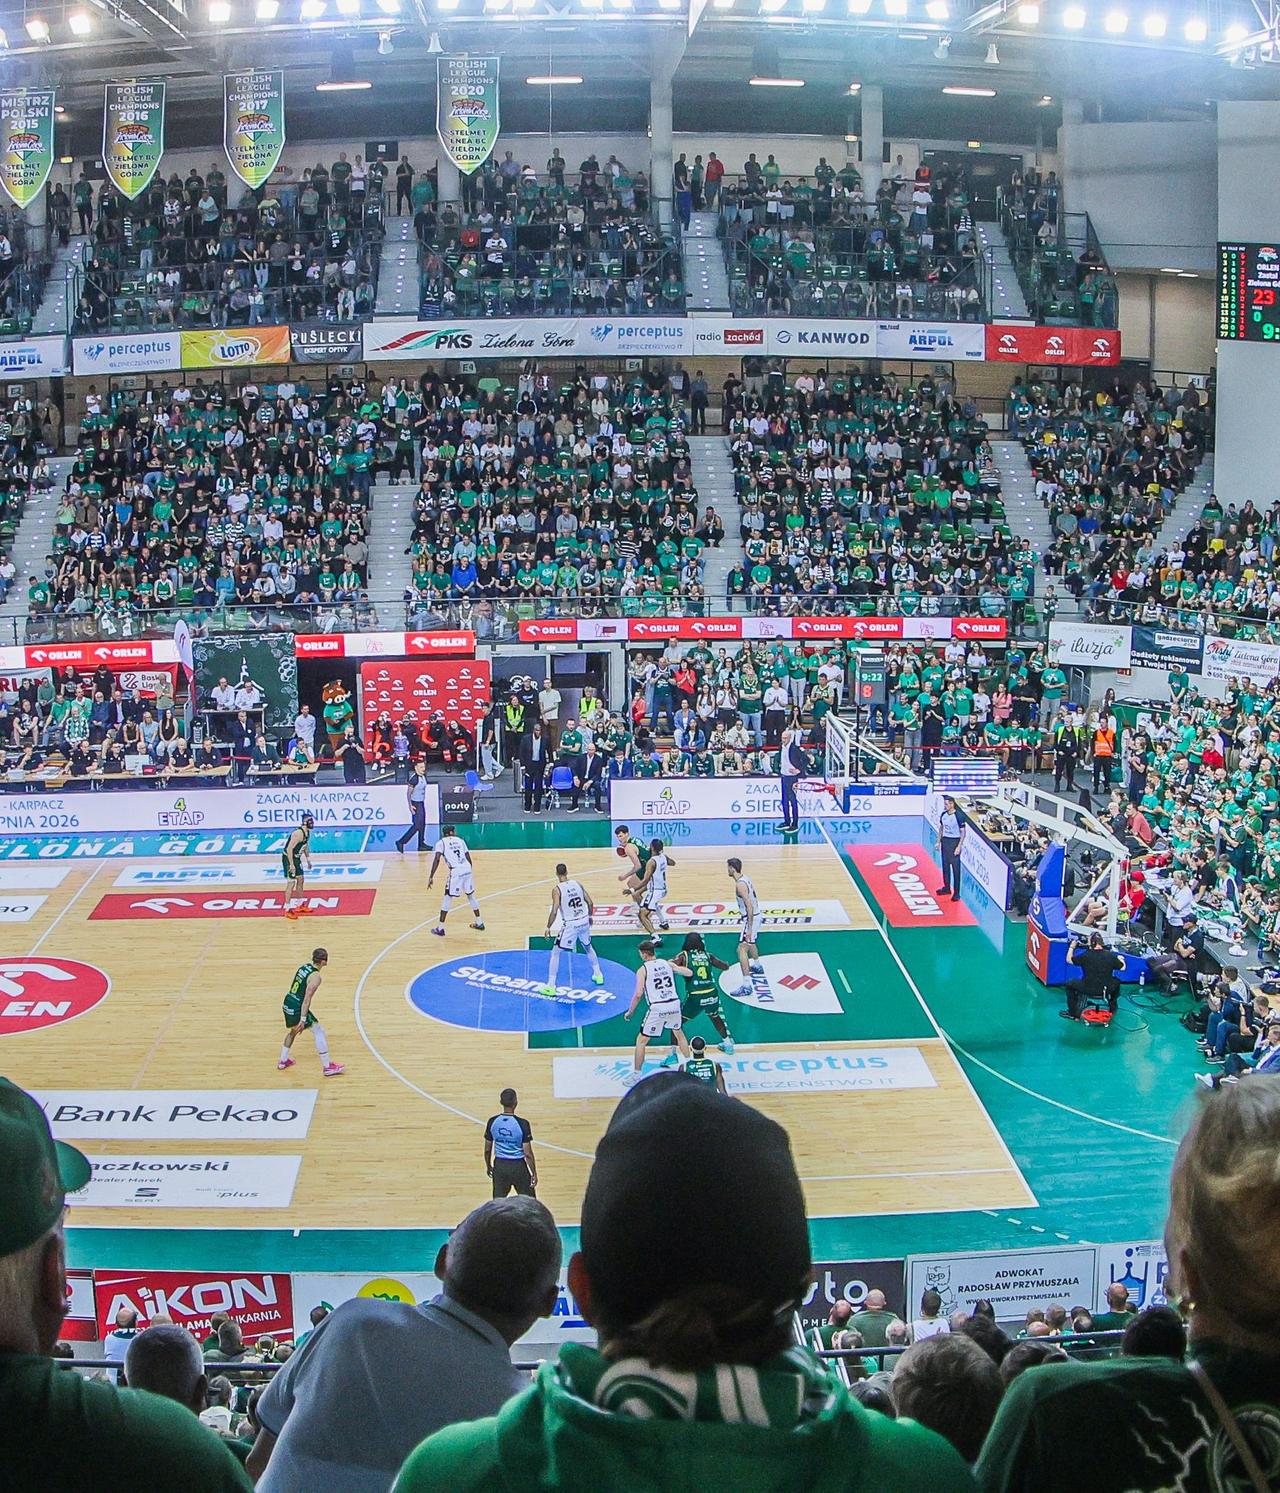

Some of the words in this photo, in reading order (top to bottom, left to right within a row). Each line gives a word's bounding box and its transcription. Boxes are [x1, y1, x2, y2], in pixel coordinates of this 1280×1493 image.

[449, 61, 487, 69] POLISH
[235, 75, 272, 84] POLISH
[117, 86, 154, 94] POLISH
[237, 84, 270, 92] LEAGUE
[451, 85, 485, 96] 2020
[1, 96, 50, 108] MISTRZ
[229, 91, 279, 101] CHAMPIONS
[109, 103, 159, 111] CHAMPIONS
[239, 101, 269, 111] 2017
[1, 107, 49, 118] POLSKI
[119, 111, 149, 121] 2016
[10, 120, 39, 130] 2015
[237, 152, 272, 161] ZIELONA
[114, 162, 149, 170] ZIELONA
[1253, 289, 1276, 305] 23
[291, 330, 361, 344] PUŚLECKI
[618, 325, 683, 341] perceptus
[696, 332, 721, 342] radio
[727, 330, 762, 342] zachód
[798, 331, 870, 345] KANWOD
[435, 334, 472, 349] PKS
[480, 333, 534, 348] Zielona
[542, 332, 575, 348] Góra
[908, 334, 954, 347] ARPOL
[109, 341, 171, 357] perceptus
[220, 343, 250, 359] LOTTO
[0, 353, 43, 366] ARPOL
[542, 625, 572, 635] ORLEN
[649, 623, 680, 633] ORLEN
[706, 623, 737, 632] ORLEN
[813, 623, 842, 632] ORLEN
[869, 623, 898, 632] ORLEN
[970, 623, 1000, 632] ORLEN
[302, 640, 339, 651] ORLEN
[430, 637, 467, 648] ORLEN
[48, 650, 82, 660] ORLEN
[111, 647, 146, 659] ORLEN
[1070, 638, 1113, 660] iluzja
[1205, 642, 1232, 657] Sushi
[1161, 653, 1201, 665] reklamowe
[1143, 660, 1168, 671] Twojej
[257, 791, 299, 805] ŻAGAŃ
[310, 791, 370, 804] KARPACZ
[9, 799, 65, 811] KARPACZ
[641, 800, 691, 815] ETAP
[158, 811, 205, 827] ETAP
[257, 807, 338, 823] SIERPNIA
[343, 806, 386, 821] 2026
[40, 814, 80, 828] 2026
[133, 871, 237, 879] ARPOL
[889, 872, 944, 916] ORLEN
[568, 897, 583, 909] 42
[653, 976, 673, 990] 23
[52, 1105, 158, 1122] Bank
[168, 1104, 299, 1122] Pekao
[995, 1268, 1044, 1280] ADWOKAT
[958, 1280, 1012, 1293] RADOSŁAW
[1013, 1277, 1080, 1291] PRZYMUSZAŁA
